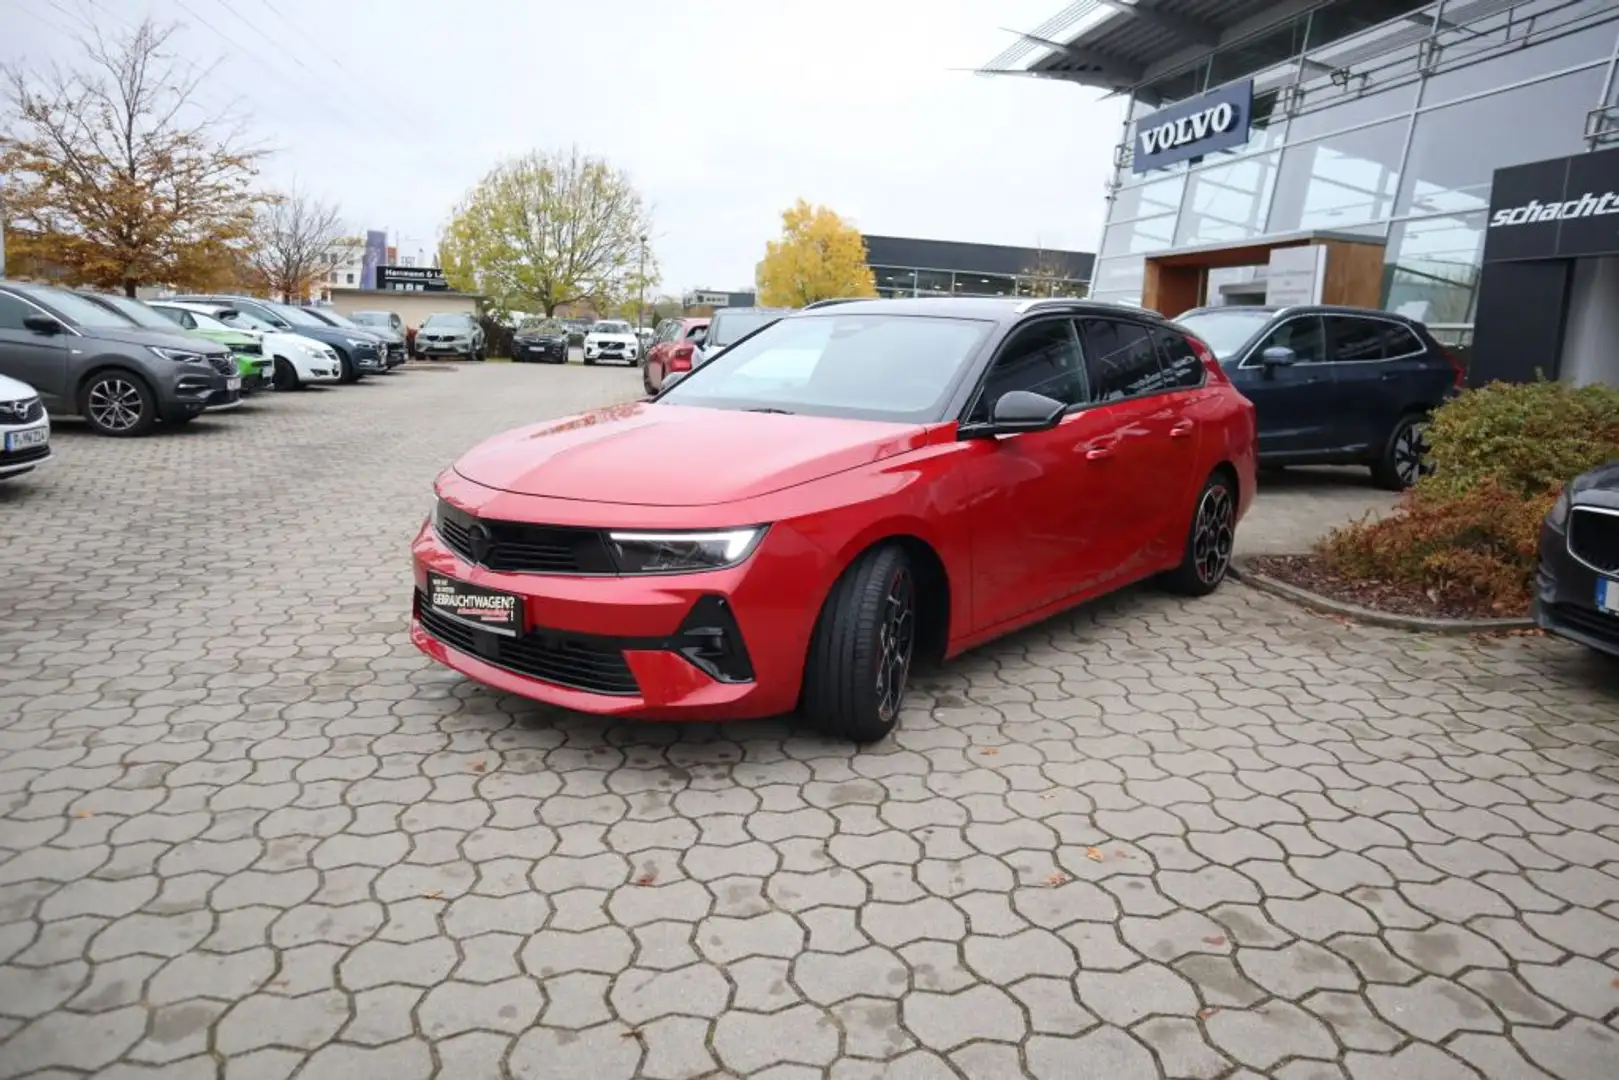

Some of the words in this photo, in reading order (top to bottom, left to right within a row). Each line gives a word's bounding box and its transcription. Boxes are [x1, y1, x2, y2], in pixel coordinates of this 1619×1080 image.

[1140, 102, 1232, 155] VOLVO
[426, 270, 433, 278] &
[433, 593, 515, 609] GEBRAUCHTWAGEN?
